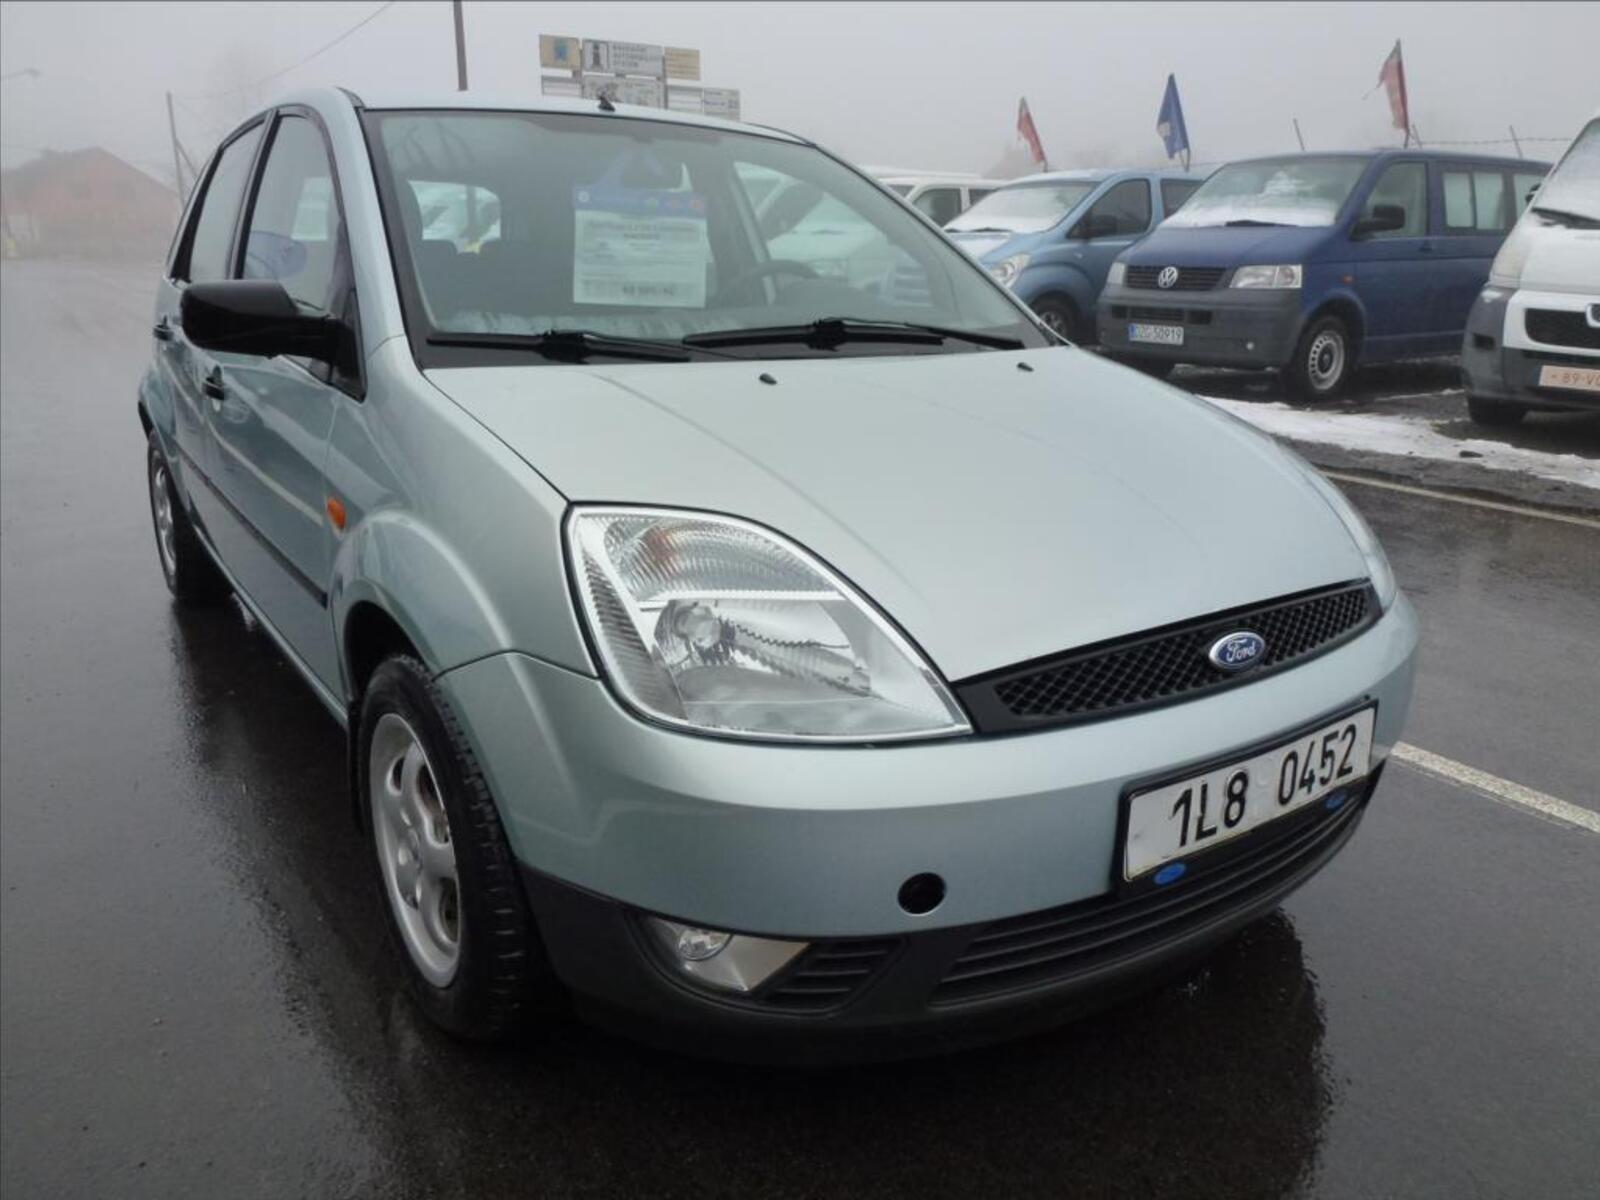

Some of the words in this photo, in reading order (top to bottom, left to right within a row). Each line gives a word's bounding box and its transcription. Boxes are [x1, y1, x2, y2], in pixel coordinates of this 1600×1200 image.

[1225, 638, 1256, 663] Ford
[1169, 769, 1249, 847] 1L8
[1277, 724, 1357, 806] 0452
